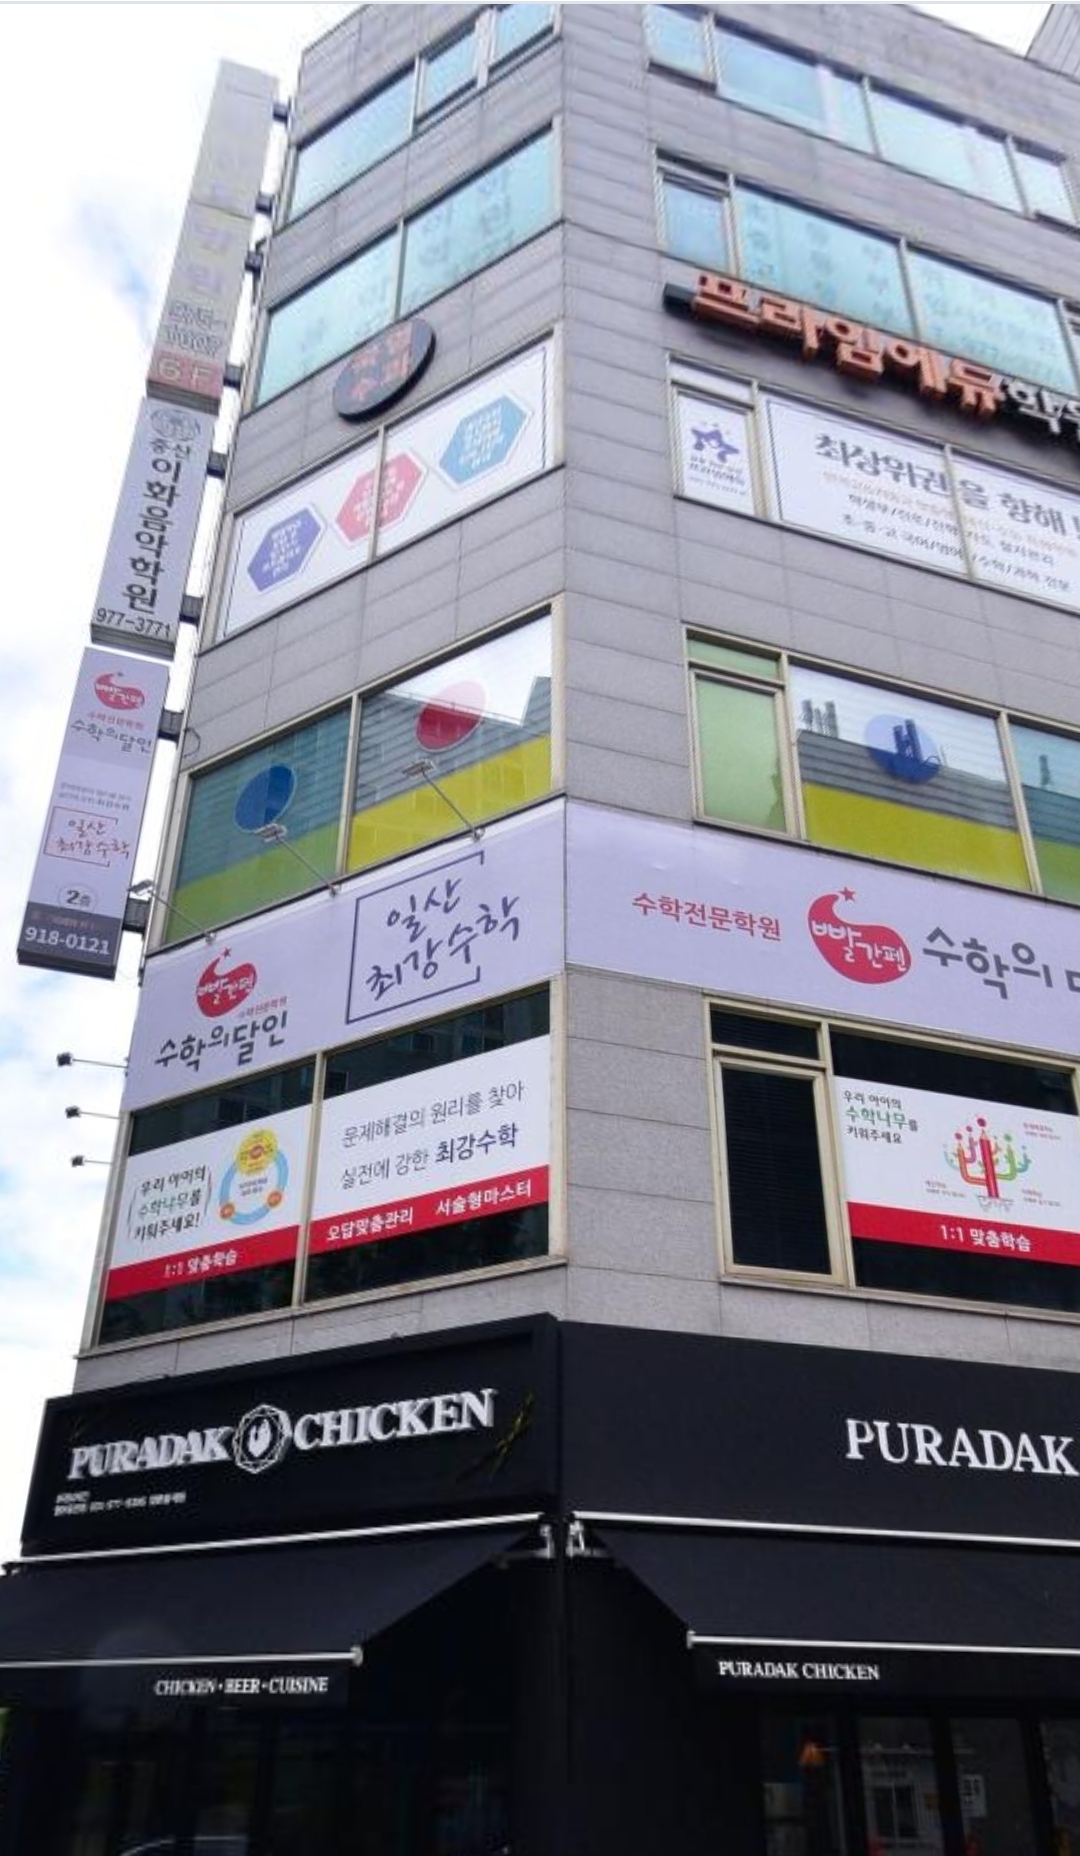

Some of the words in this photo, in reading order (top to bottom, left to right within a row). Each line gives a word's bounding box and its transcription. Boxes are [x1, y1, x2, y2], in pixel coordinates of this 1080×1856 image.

[693, 274, 1004, 419] 프라임에듀
[122, 458, 181, 614] 이화음악학원
[97, 608, 171, 637] 977-3771
[69, 820, 106, 838] 일산
[387, 878, 462, 943] 일산
[632, 891, 782, 942] 수학전문학원
[25, 926, 110, 955] 918-0121
[366, 896, 520, 1001] 최강수학
[811, 919, 909, 972] 빨간펜
[155, 1010, 288, 1073] 수학의달인
[341, 1107, 425, 1148] 문제해결의
[431, 1091, 482, 1125] 원리를
[488, 1080, 525, 1108] 찾아
[843, 1089, 865, 1104] 우리
[846, 1105, 918, 1132] 수학나무를
[341, 1158, 390, 1190] 실전에
[396, 1148, 429, 1177] 강한
[435, 1122, 519, 1163] 최강수학
[847, 1126, 902, 1144] 키워주세요
[138, 1187, 202, 1217] 수학나무를
[141, 1177, 166, 1197] 우리
[326, 1207, 414, 1241] 오답맞춤관리
[435, 1179, 532, 1216] 서술형마스터
[164, 1261, 184, 1279] 1:1
[186, 1249, 239, 1275] 맞춤학습
[940, 1224, 965, 1243] 1:1
[970, 1229, 1032, 1253] 맞춤학습
[66, 1425, 233, 1480] PURADAK
[293, 1388, 498, 1451] CHICKEN
[845, 1418, 1080, 1477] PURADAK
[718, 1660, 799, 1679] PURADAK
[802, 1662, 880, 1680] CHICKEN
